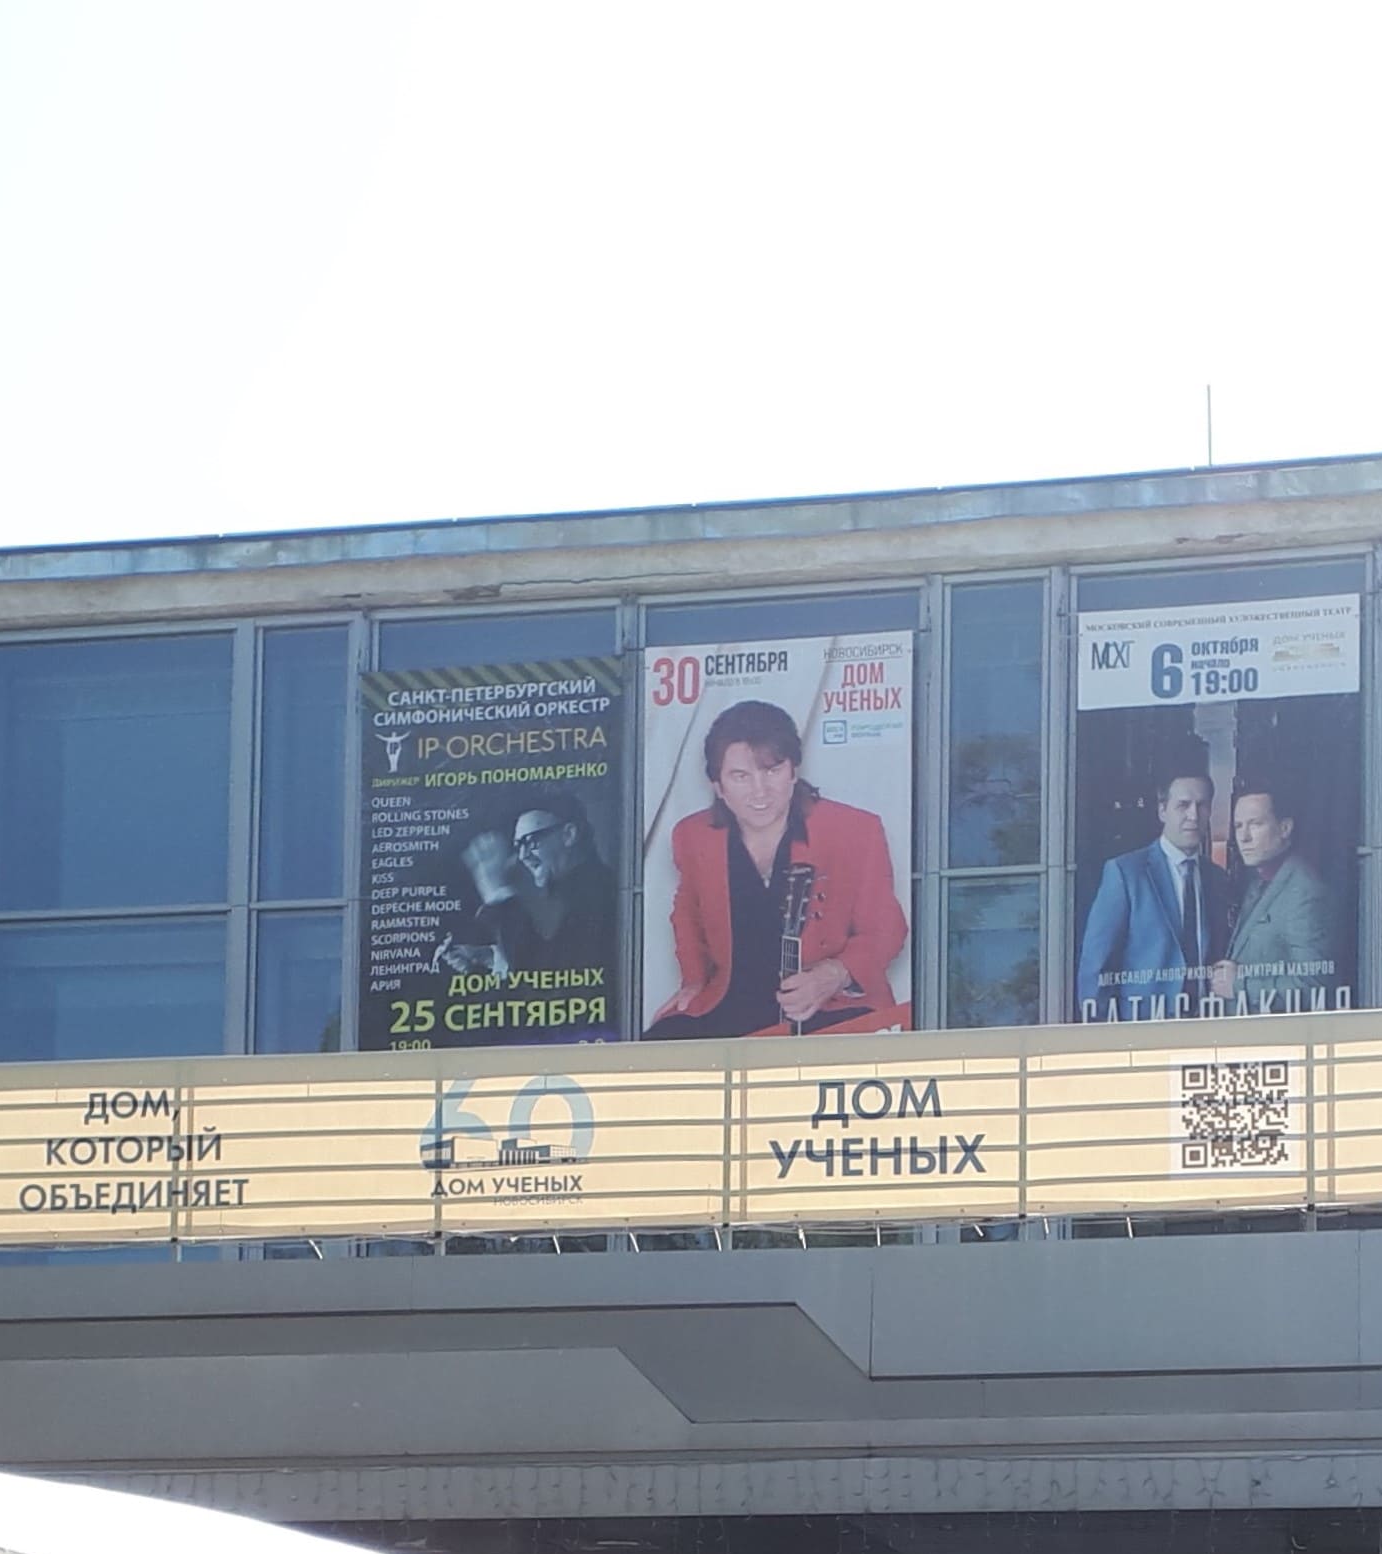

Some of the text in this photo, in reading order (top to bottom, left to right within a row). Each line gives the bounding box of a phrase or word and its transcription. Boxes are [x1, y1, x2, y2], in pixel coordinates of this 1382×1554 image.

[823, 644, 903, 659] НОВОСИБИРСК
[652, 651, 788, 706] 30 СЕНТЯБРЯ
[841, 661, 885, 689] ДОМ
[1151, 643, 1184, 699] 6
[1191, 668, 1259, 696] 19:00
[387, 676, 596, 706] САНКТ-ПЕТЕРБУРГСКИЙ
[823, 687, 903, 714] УЧЕНЫХ
[373, 697, 610, 726] СИМФОНИЧЕСКИЙ ОРКЕСТР
[418, 726, 608, 759] IP ORCHESTRA
[425, 771, 477, 787] ИГОРЬ
[481, 763, 608, 784] ПОНОМАРЕНКО
[371, 797, 411, 808] QUEEN
[371, 808, 469, 823] ROLLING STONES
[372, 825, 450, 838] LED ZEPPELIN
[372, 841, 439, 854] AEROSMITH
[372, 856, 413, 869] EAGLES
[372, 872, 394, 884] KISS
[372, 886, 447, 899] DEEP PURPLE
[372, 900, 461, 915] DEPECHE MODE
[371, 916, 440, 931] RAMMSTEIN
[371, 931, 436, 946] SCORPIONS
[371, 948, 421, 961] NIRVANA
[370, 961, 440, 976] ЛЕНИНГРАД
[1098, 969, 1153, 988] АЛЕКСАНДР
[1237, 961, 1284, 979] ДМИТРИЙ
[370, 979, 401, 992] АРИЯ
[448, 967, 604, 997] ДОМ УЧЕНЫХ
[390, 996, 607, 1034] 25 СЕНТЯБРЯ
[84, 1090, 180, 1125] ДОМ,
[811, 1077, 944, 1129] ДОМ
[45, 1126, 222, 1166] КОТОРЫЙ
[768, 1133, 987, 1179] УЧЕНЫХ
[19, 1178, 249, 1215] ОБЪЕДИНЯЕТ
[430, 1175, 584, 1198] ДОМ УЧЕНЫХ
